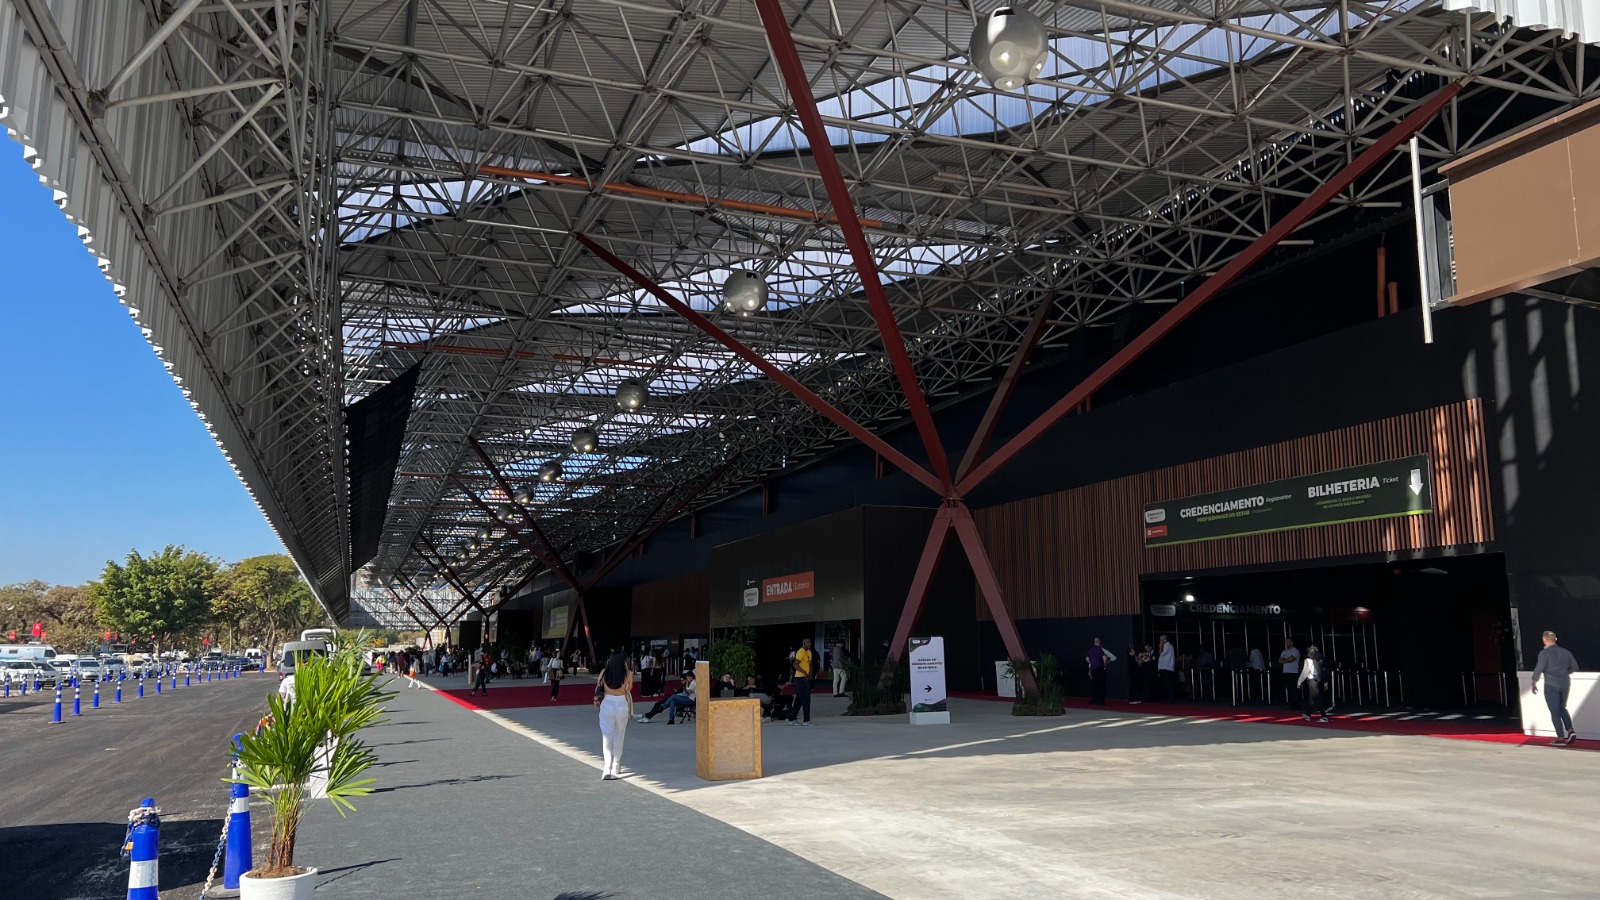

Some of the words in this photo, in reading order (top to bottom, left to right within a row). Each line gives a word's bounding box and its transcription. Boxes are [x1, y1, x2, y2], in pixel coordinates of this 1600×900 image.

[1307, 476, 1380, 498] BILHETERIA
[1382, 476, 1399, 484] Ticket
[1180, 495, 1265, 518] CREDENCIAMENTO
[766, 581, 793, 596] ENTRADA
[1189, 603, 1281, 614] CREDENCIAMENTO
